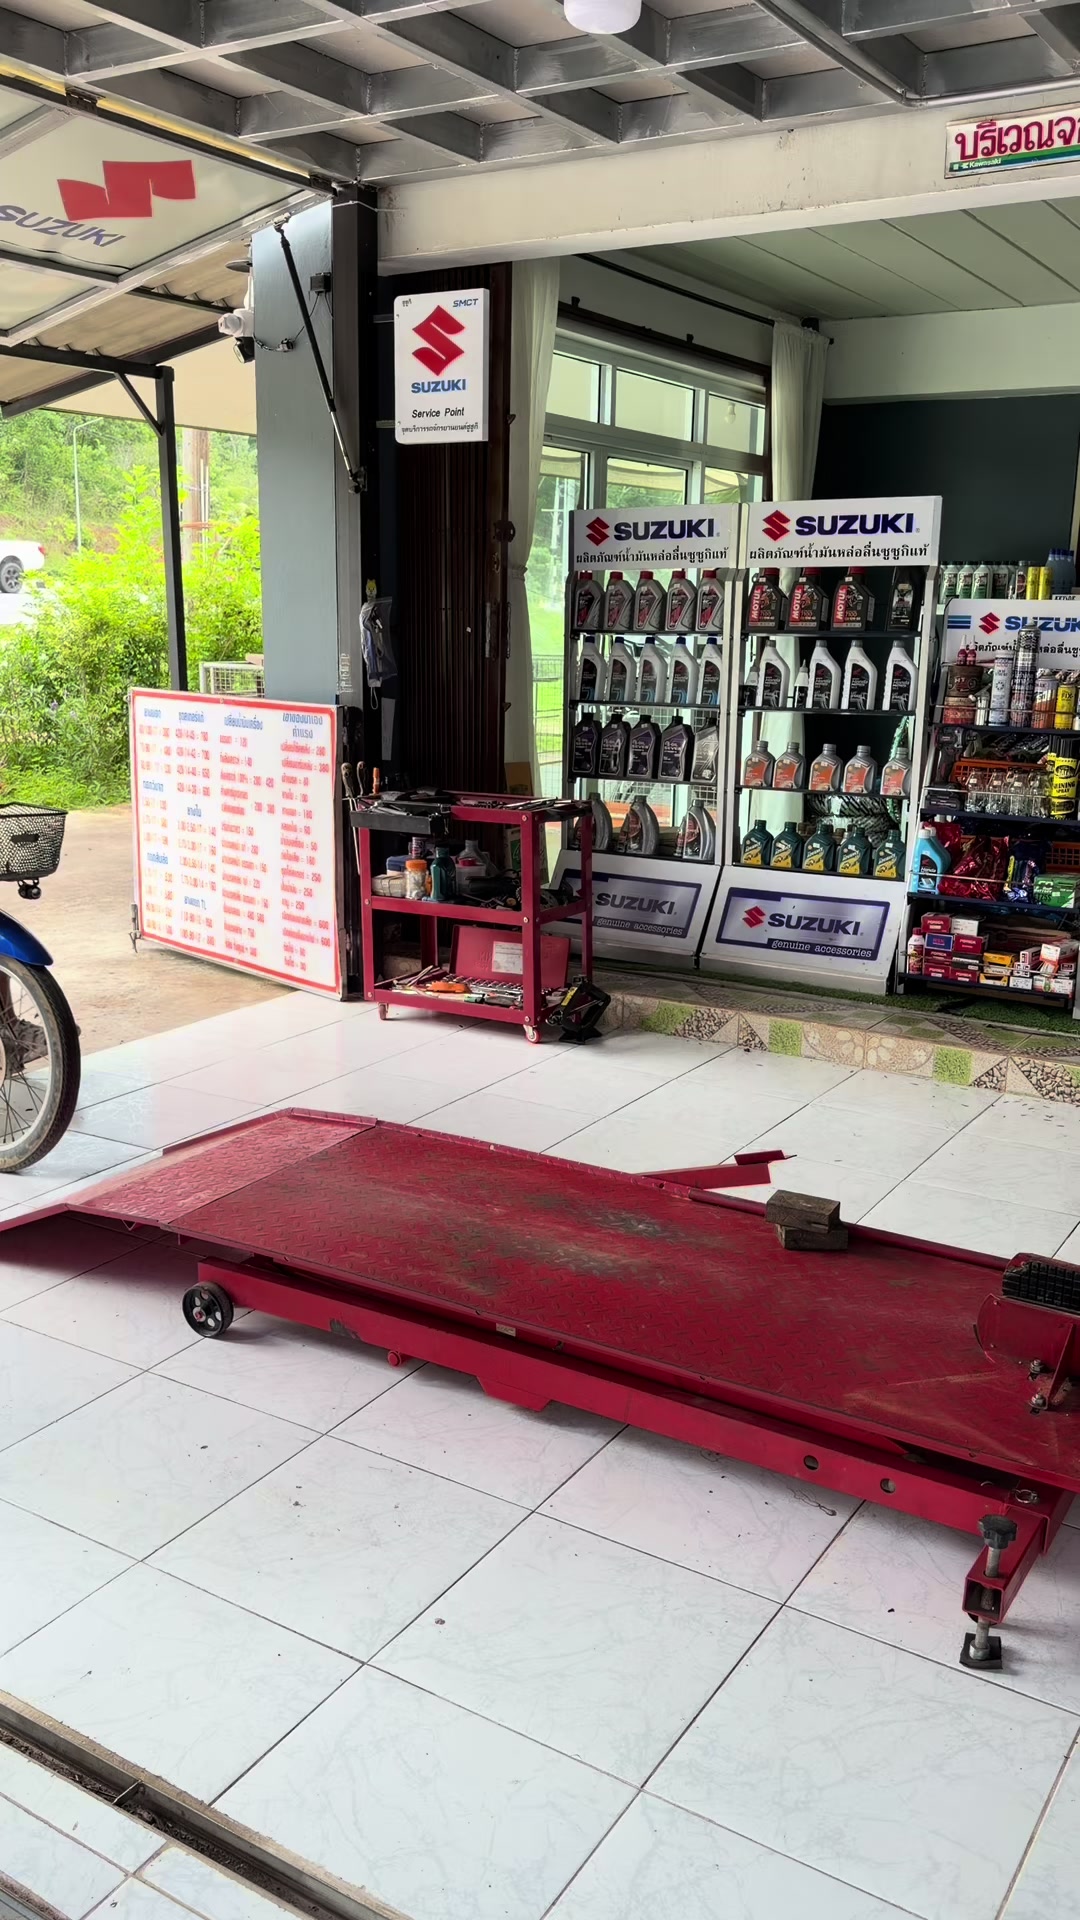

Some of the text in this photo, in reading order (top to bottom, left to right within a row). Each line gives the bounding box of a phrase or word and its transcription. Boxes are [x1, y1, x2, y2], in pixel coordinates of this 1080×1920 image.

[955, 117, 1080, 160] บริเวณจ
[0, 205, 126, 247] SUZUKI
[453, 298, 478, 307] SMCT
[411, 379, 466, 394] SUZUKI
[412, 407, 464, 418] Service Point
[614, 518, 714, 541] SUZUKI
[796, 513, 914, 536] SUZUKI
[576, 545, 728, 563] ผลิตภัณฑ์น้ำมันหล่อลื่นซูซูกิแท้
[749, 541, 929, 560] ผลิตภัณฑ์น้ำมันหล่อลื่นซูซูกิแท้
[752, 587, 761, 619] MOTUL
[794, 587, 803, 619] MOTUL
[836, 588, 846, 620] MOTUL
[293, 725, 313, 738] ค่าแรง
[595, 893, 675, 915] SUZUKI
[597, 917, 683, 936] genuine accessories
[768, 912, 861, 936] SUZUKI
[771, 939, 872, 958] genuine accessories
